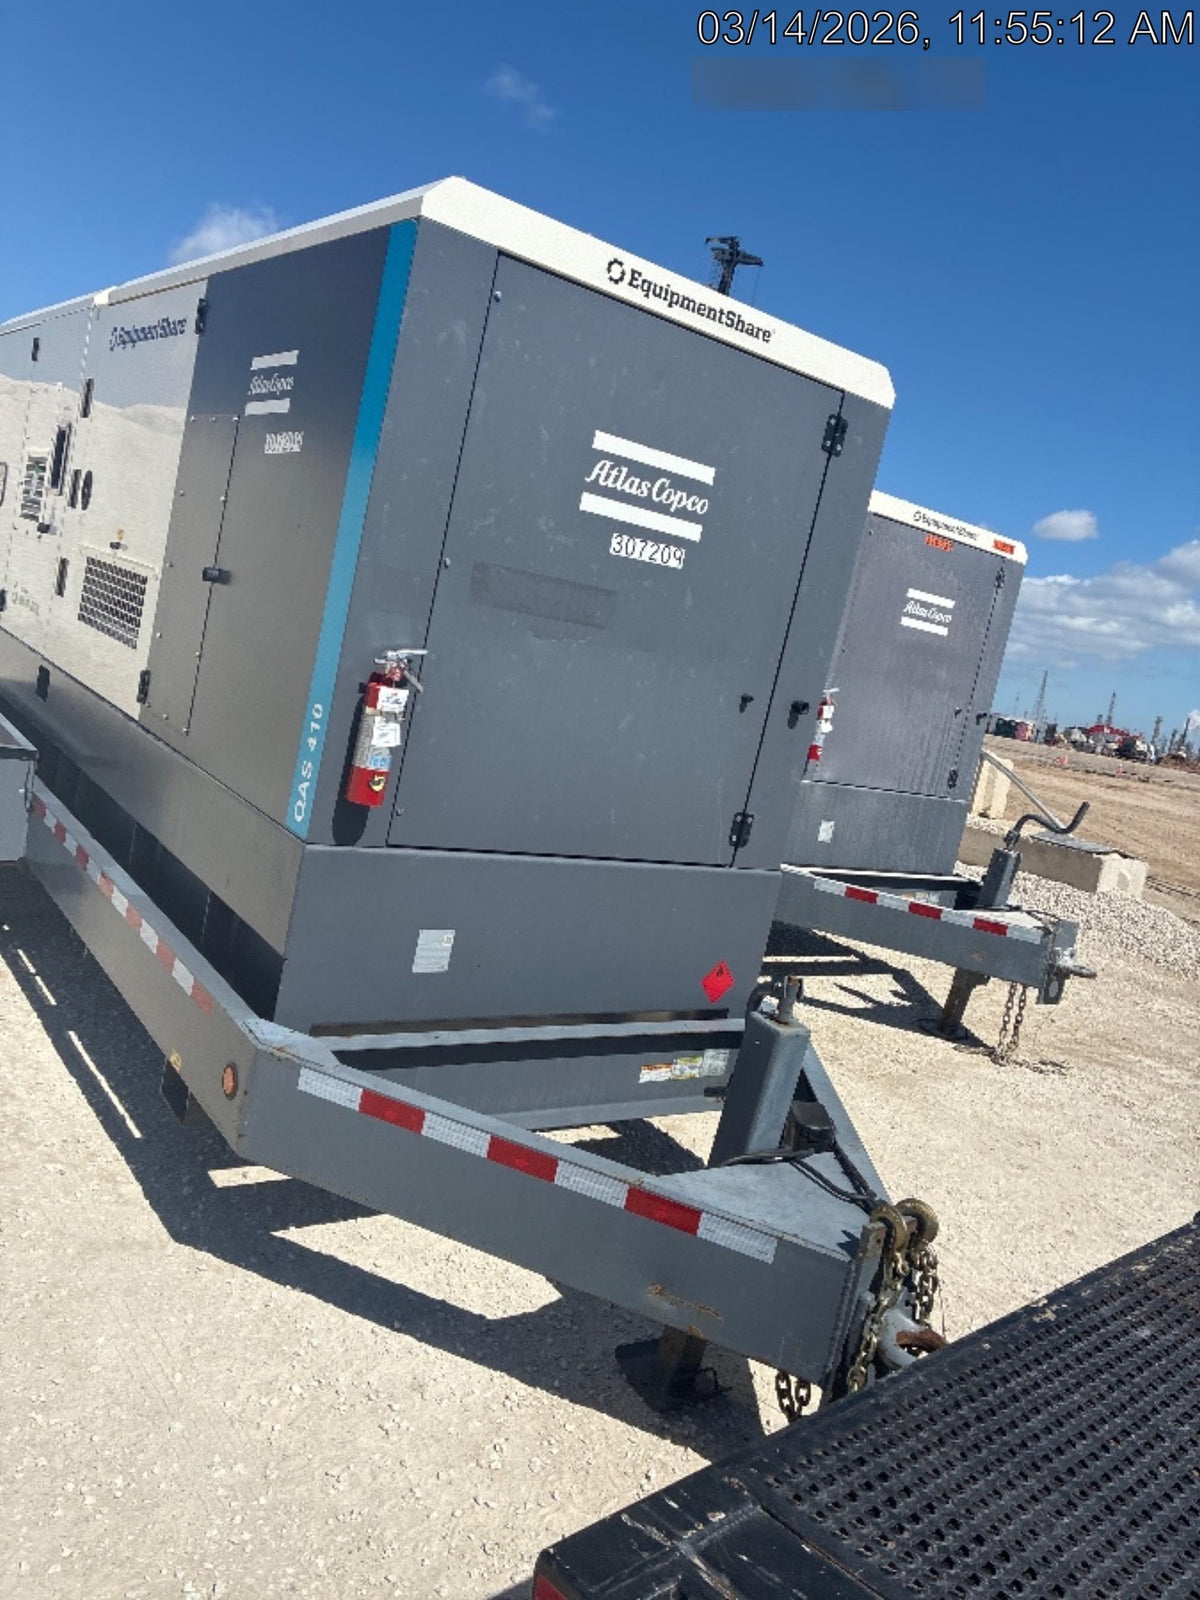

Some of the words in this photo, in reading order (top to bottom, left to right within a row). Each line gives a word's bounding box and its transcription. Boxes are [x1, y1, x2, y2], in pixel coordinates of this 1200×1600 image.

[628, 268, 772, 343] EquipmentShare
[585, 460, 651, 497] Atlas
[652, 478, 708, 514] Copco
[611, 533, 685, 568] 307209
[294, 761, 314, 822] QAS
[307, 703, 323, 752] 410
